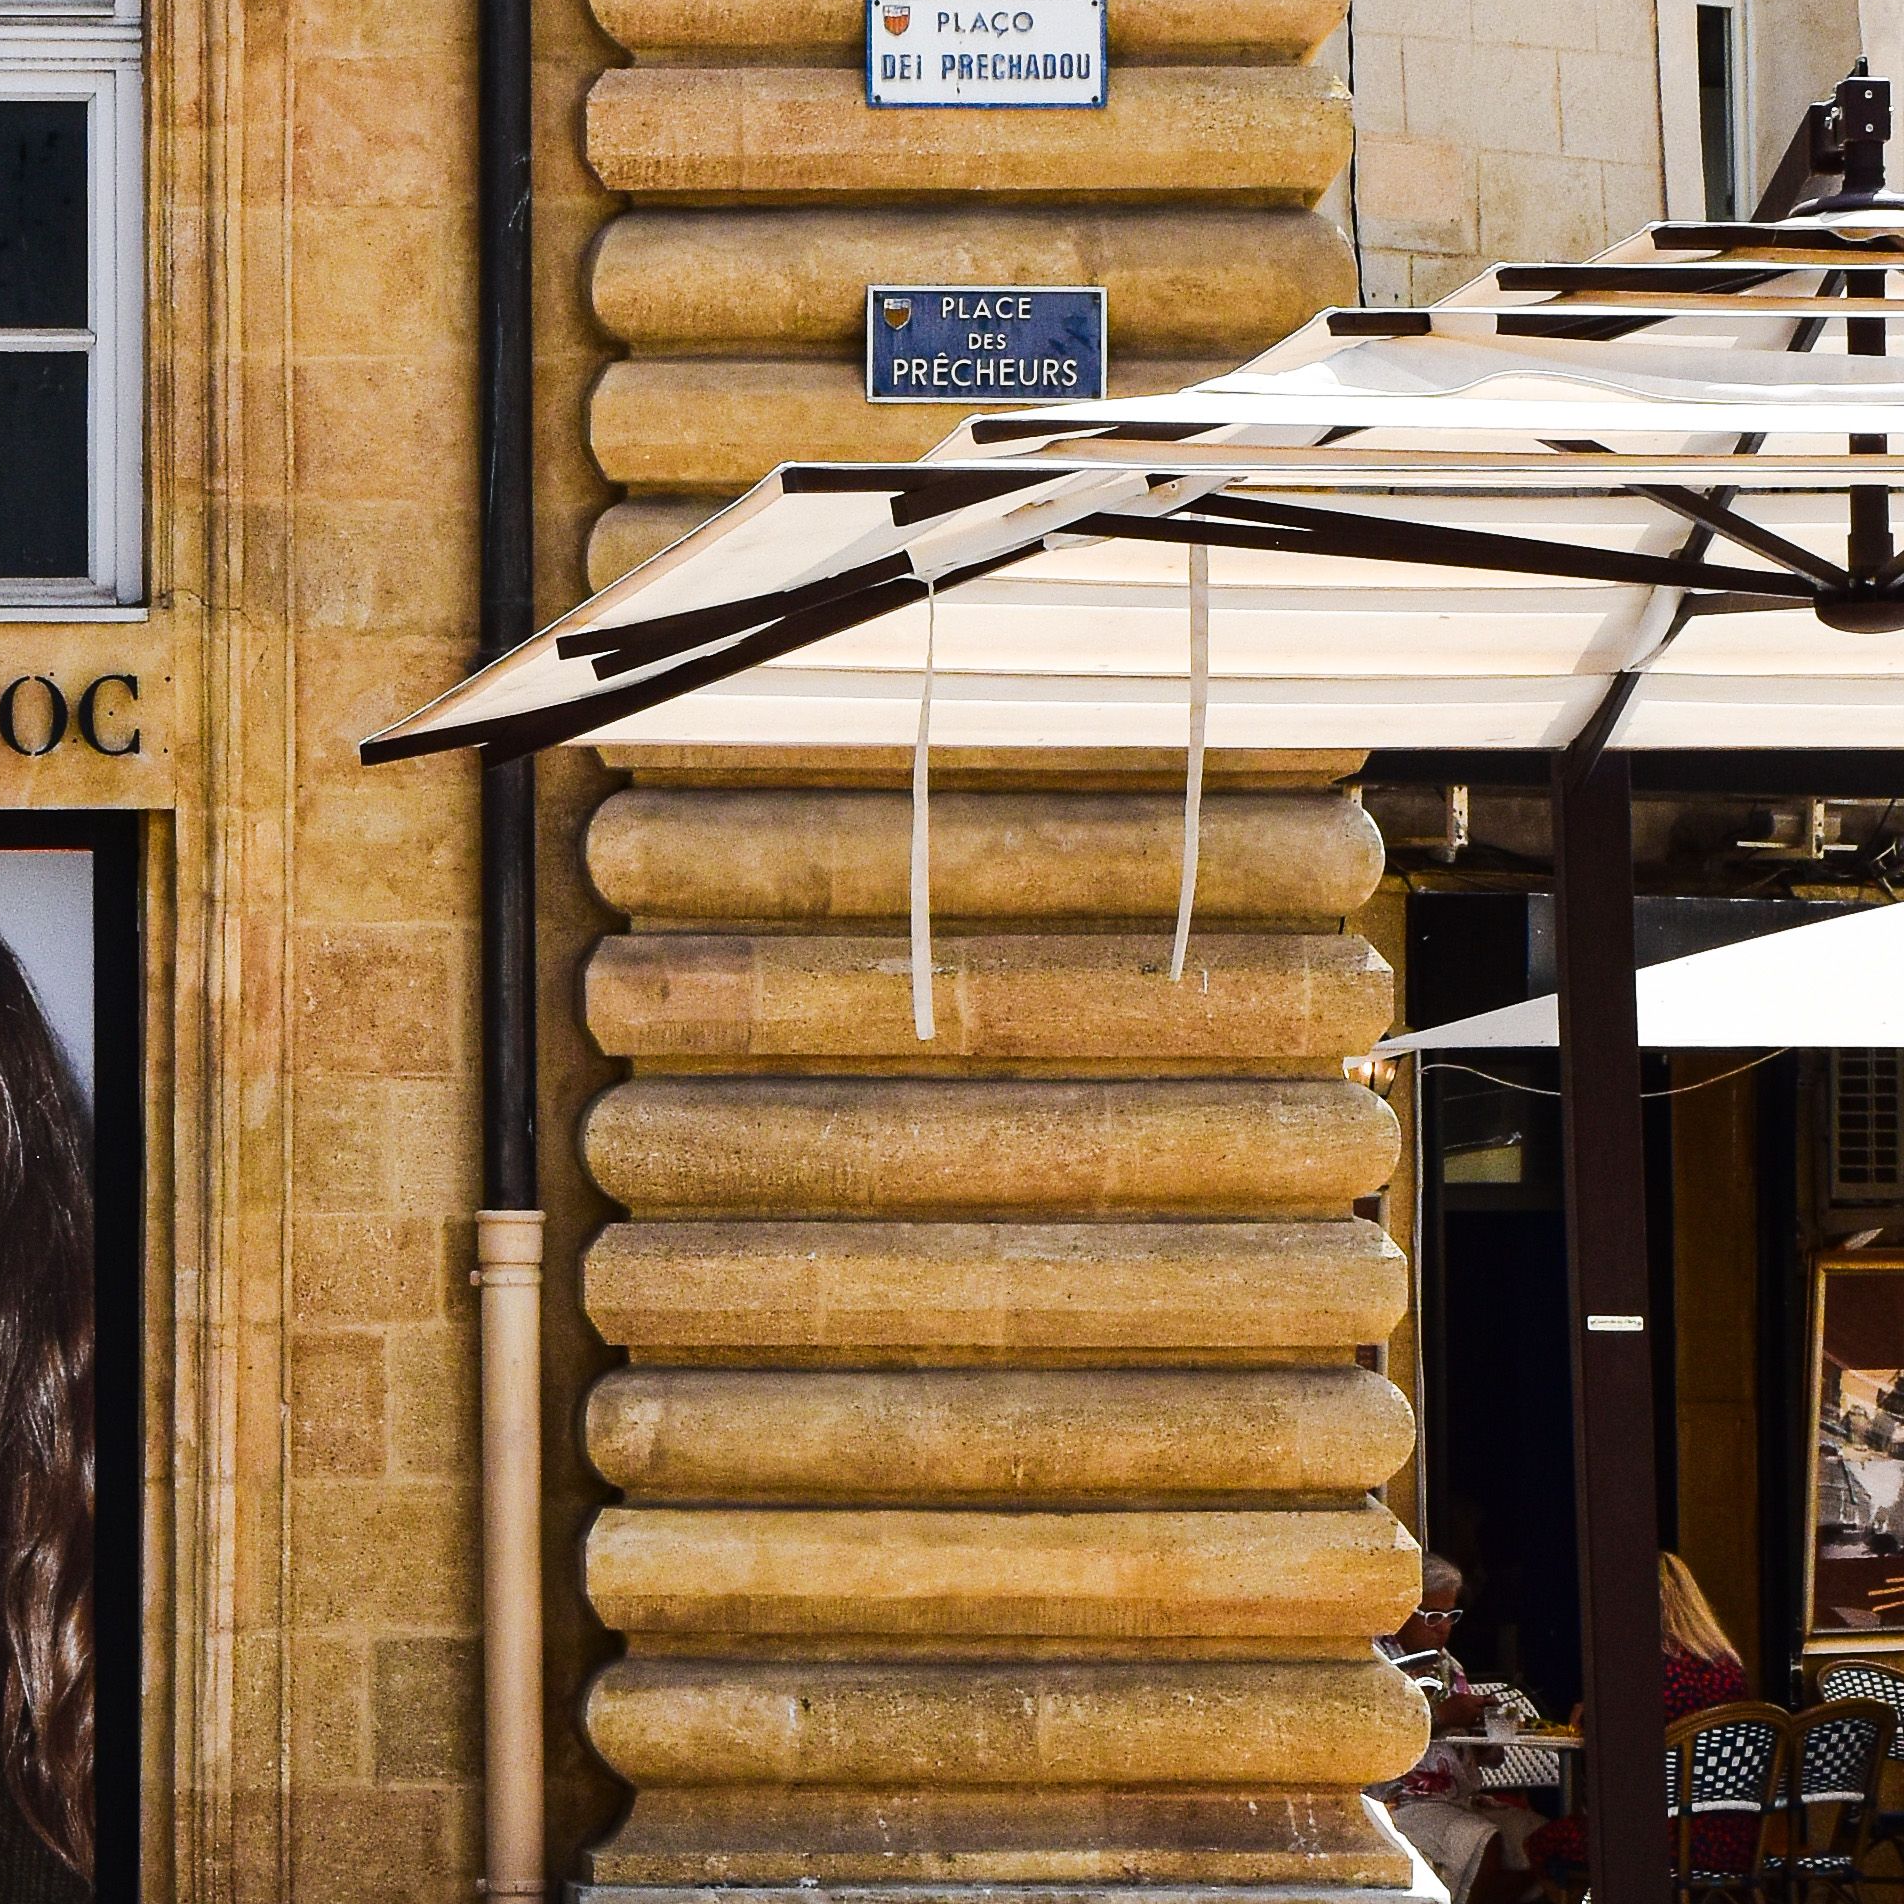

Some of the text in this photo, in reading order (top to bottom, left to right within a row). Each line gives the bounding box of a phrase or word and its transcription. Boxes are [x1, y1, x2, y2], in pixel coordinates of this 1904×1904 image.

[937, 11, 1034, 37] PLAÇO
[881, 53, 1091, 81] DEI PRECHADOU
[941, 296, 1032, 319] PLACE
[968, 332, 1007, 350] DES
[893, 352, 1078, 387] PRÊCHEURS
